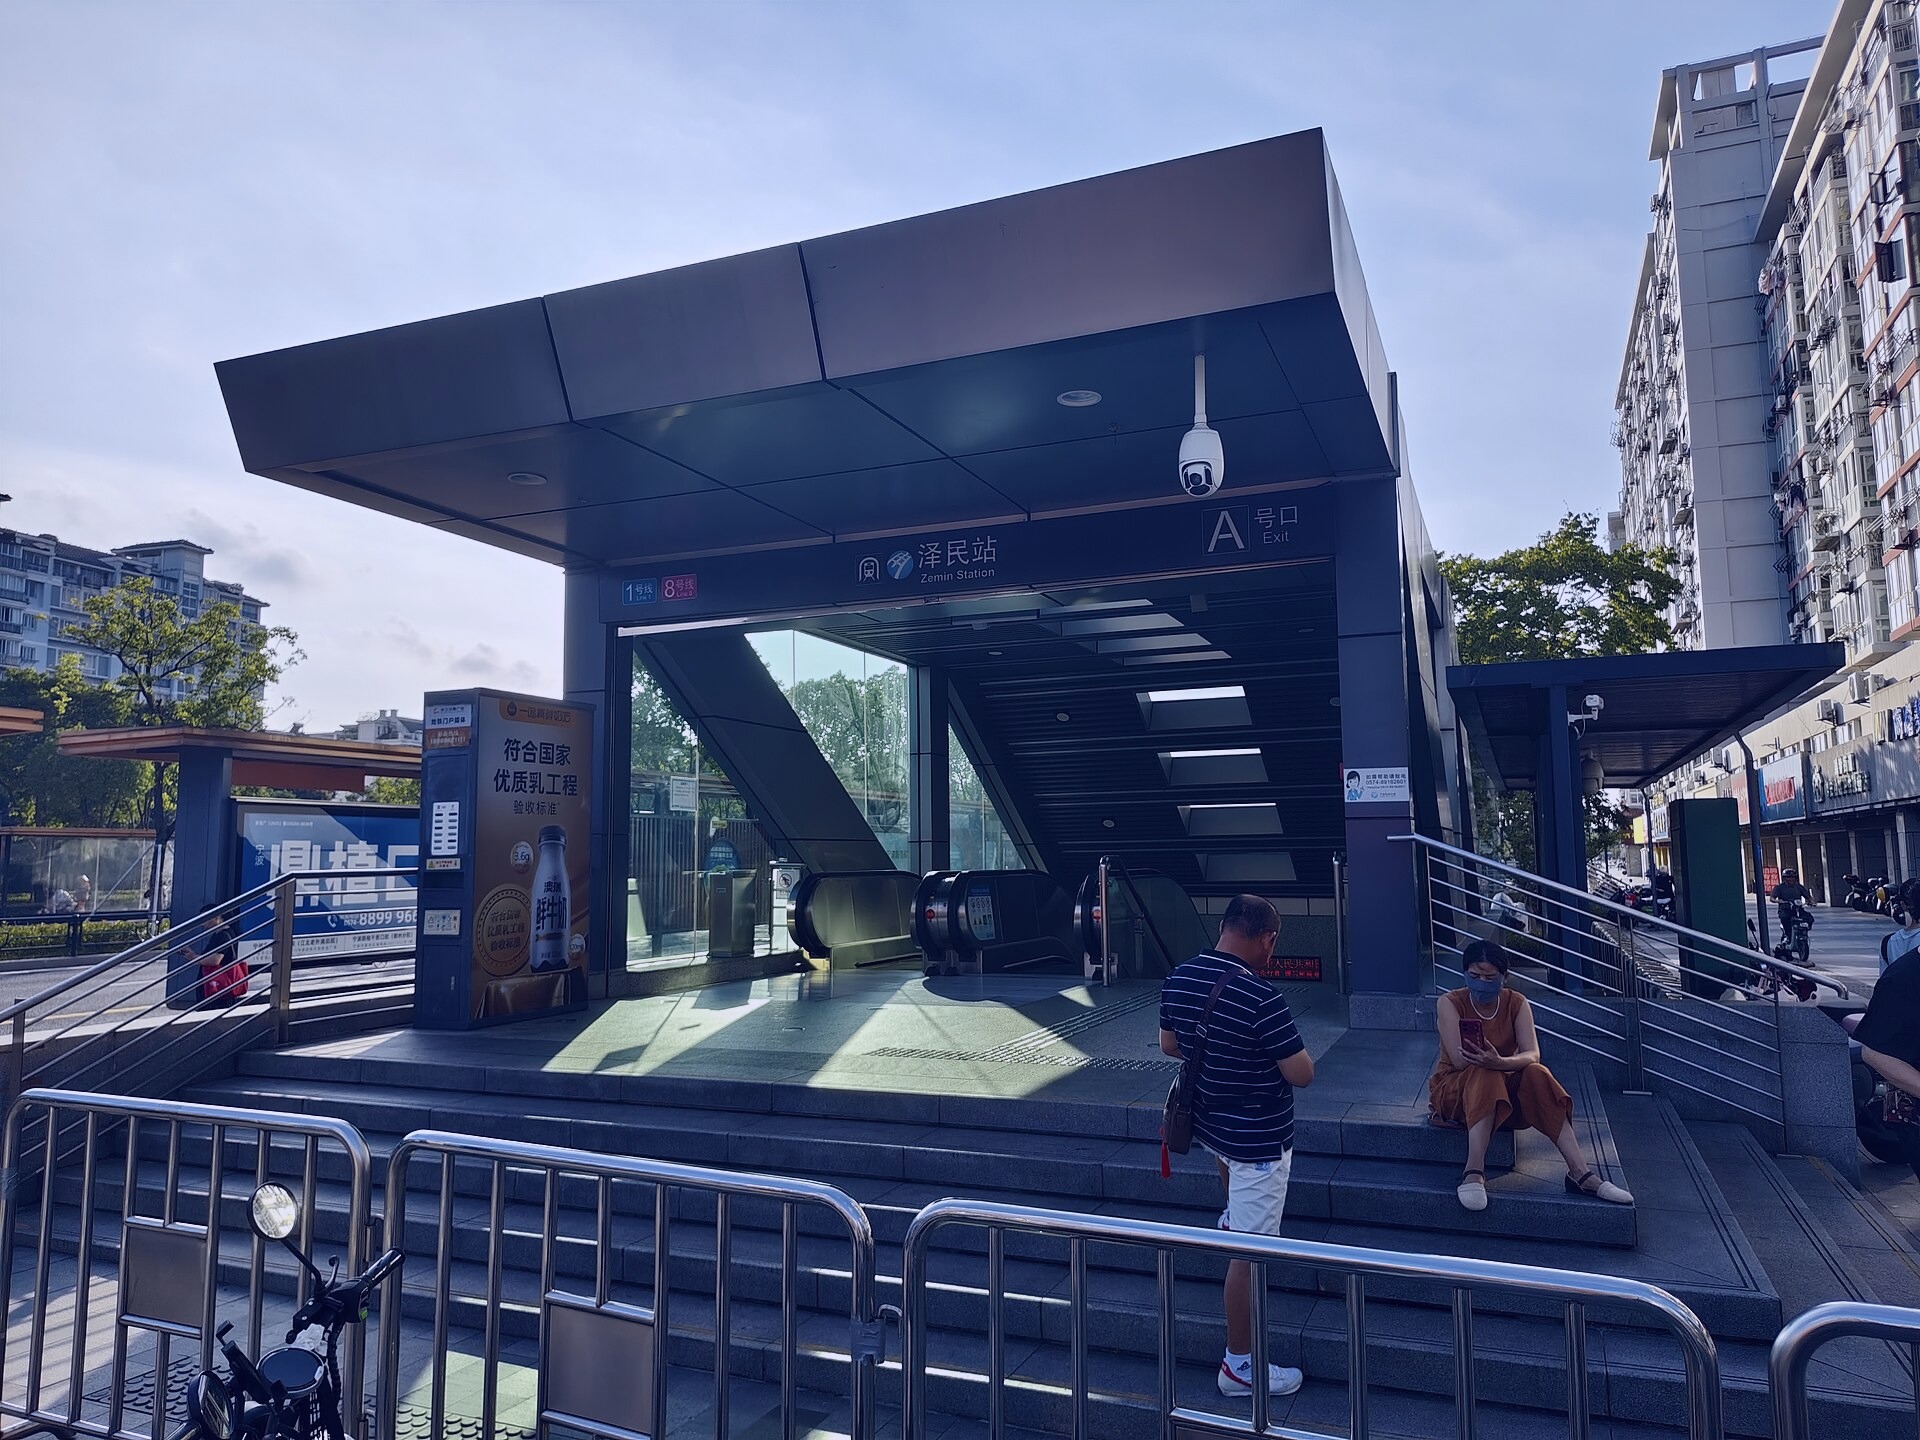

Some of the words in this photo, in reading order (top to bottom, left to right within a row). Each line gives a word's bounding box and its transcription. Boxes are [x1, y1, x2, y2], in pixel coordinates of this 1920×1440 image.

[1254, 506, 1298, 529] 号口
[1207, 510, 1245, 552] A
[1263, 530, 1289, 544] Exit
[917, 535, 997, 569] 泽民站
[920, 572, 953, 583] Zemin
[957, 568, 995, 580] Station
[625, 583, 653, 601] 1号线
[664, 578, 694, 597] 8号线
[503, 738, 571, 767] 符合国家
[493, 768, 578, 797] 优质乳工程
[513, 800, 558, 816] 验收标准
[255, 844, 264, 867] 宁波
[514, 851, 530, 863] 3.6g
